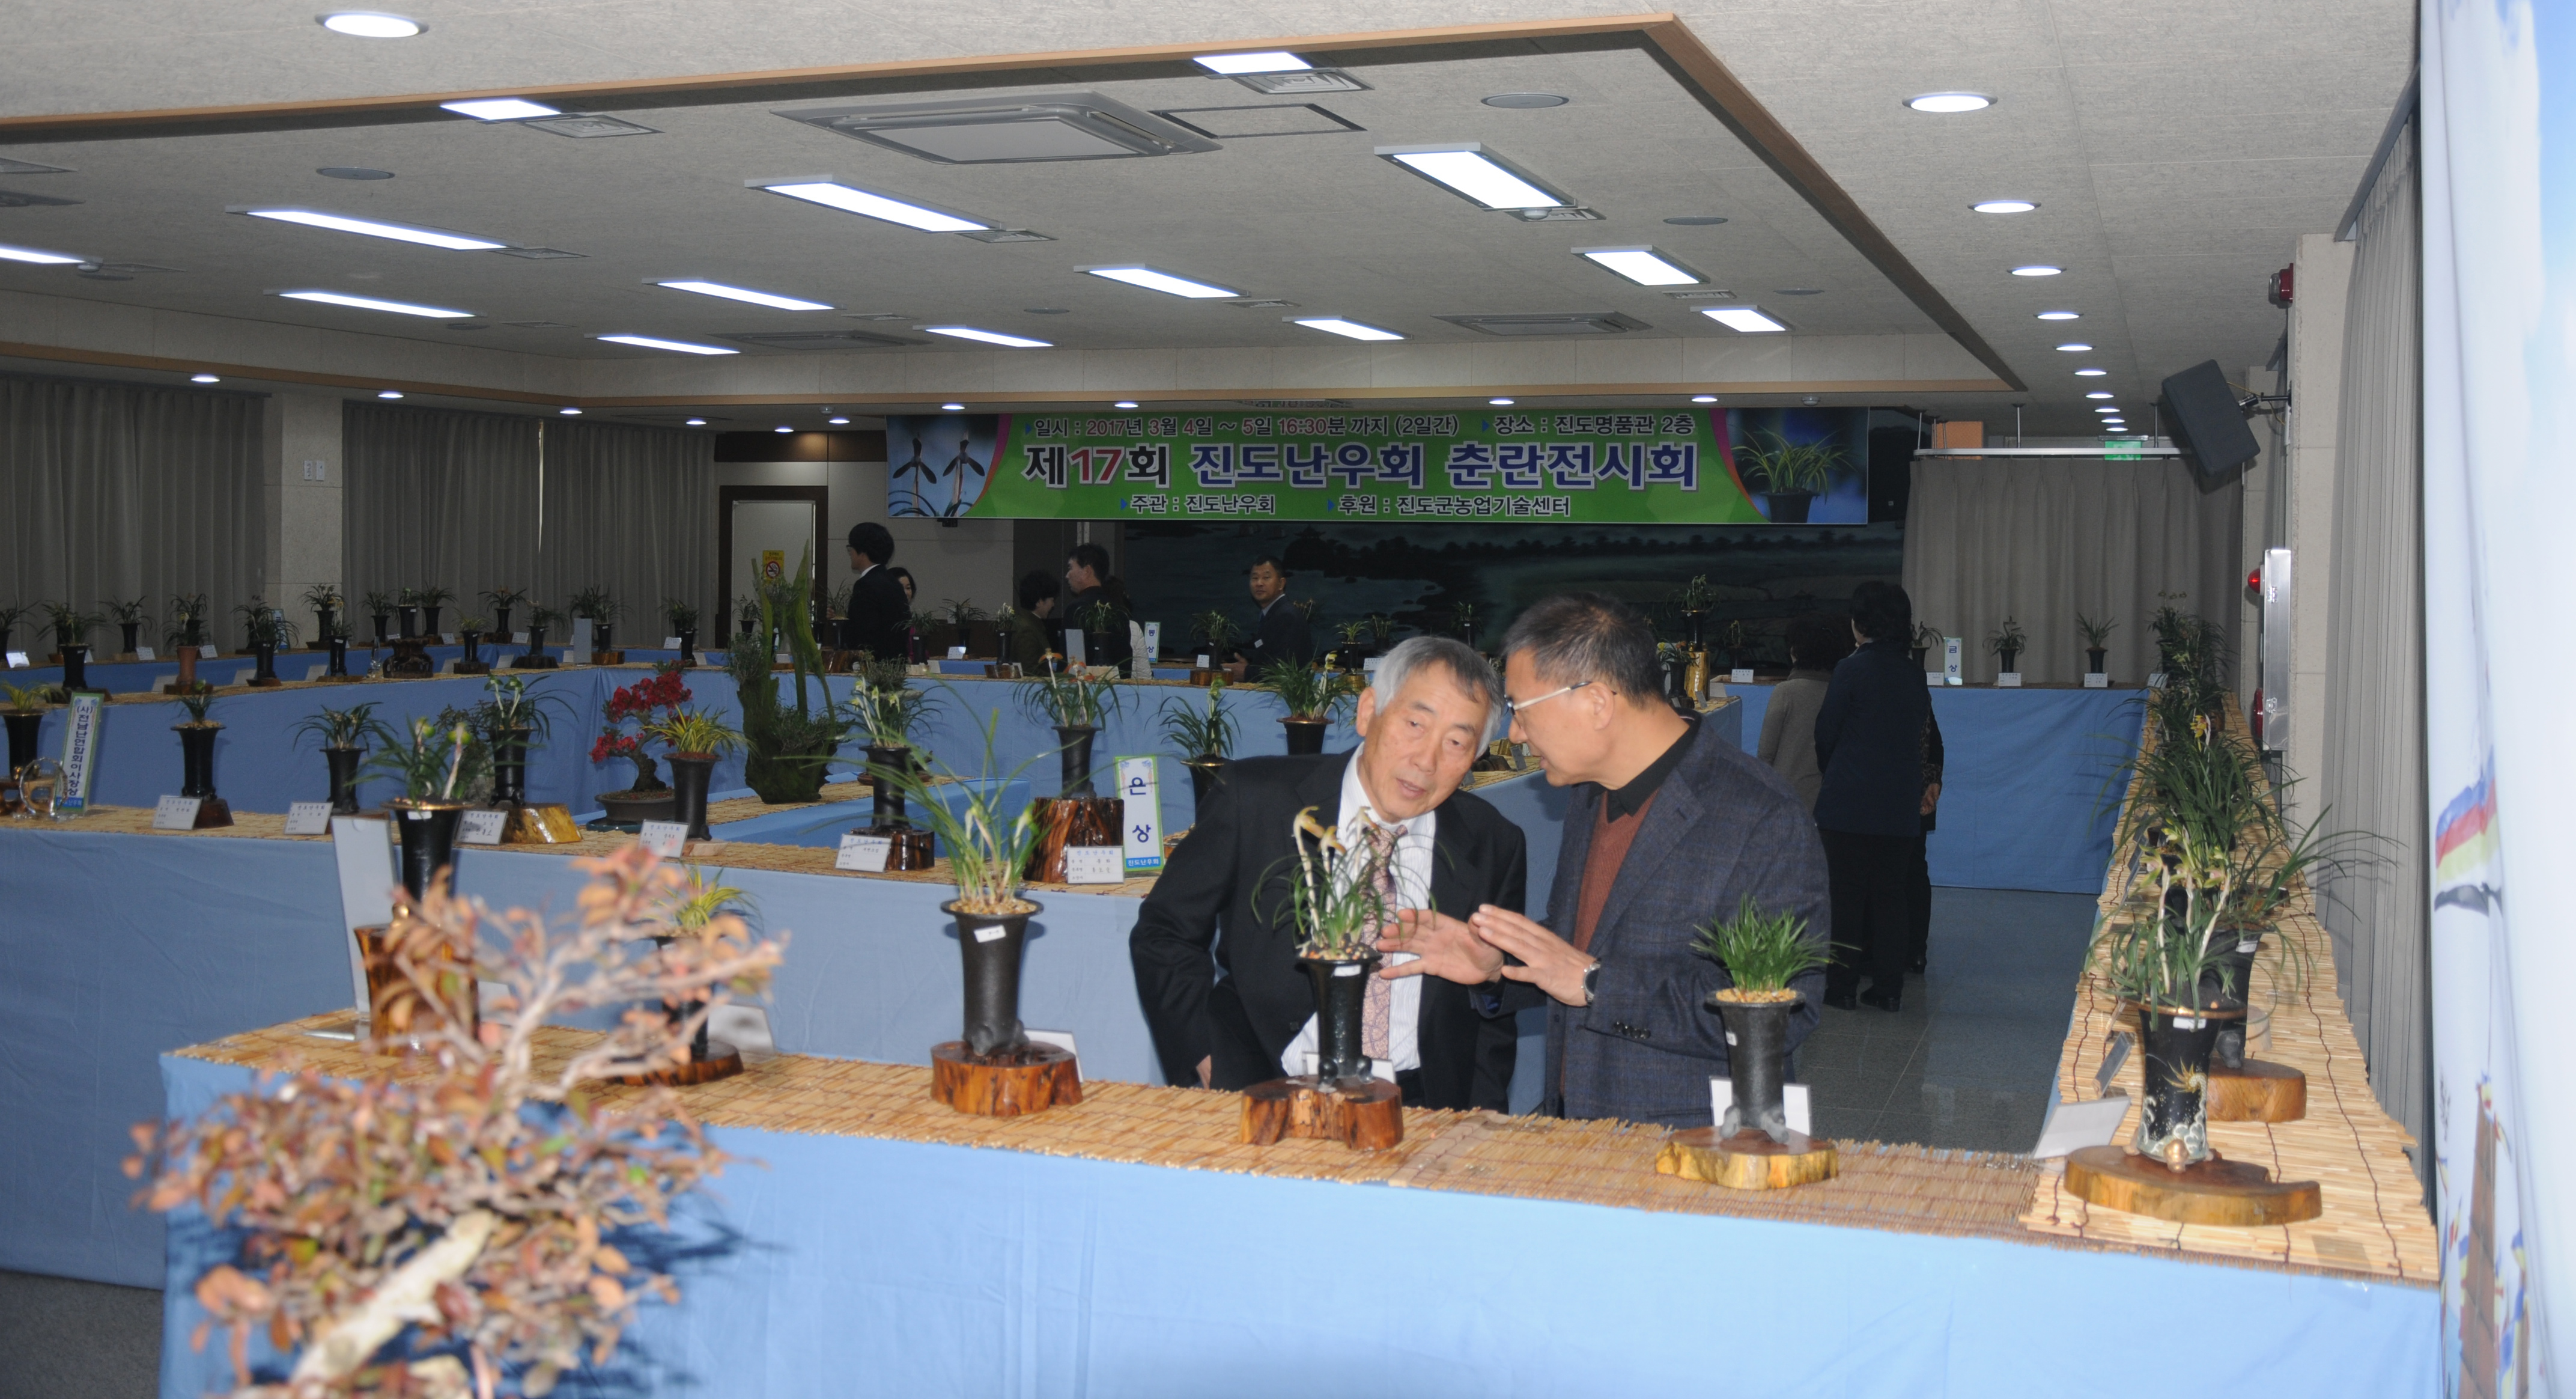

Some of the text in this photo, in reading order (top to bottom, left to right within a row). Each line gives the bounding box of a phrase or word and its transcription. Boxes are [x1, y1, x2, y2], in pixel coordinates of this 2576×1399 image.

[1034, 418, 1068, 437] 일시
[1086, 418, 1142, 437] 2017년
[1148, 417, 1177, 437] 3월
[1183, 417, 1212, 436] 4일
[1242, 417, 1272, 436] 5일
[1278, 416, 1346, 436] 16:30분
[1350, 416, 1389, 436] 까지
[1394, 415, 1459, 436] (2일간)
[1494, 415, 1535, 434] 장소
[1555, 415, 1655, 435] 진도명품관
[1661, 414, 1694, 435] 2층
[1022, 442, 1699, 489] 제17회 진도난우회 춘란전시회
[1131, 495, 1167, 514] 주관
[1186, 495, 1275, 514] 진도난우회
[1339, 495, 1378, 515] 후원
[1396, 495, 1570, 516] 진도군농업기술센터
[1128, 858, 1159, 867] 진도난우회
